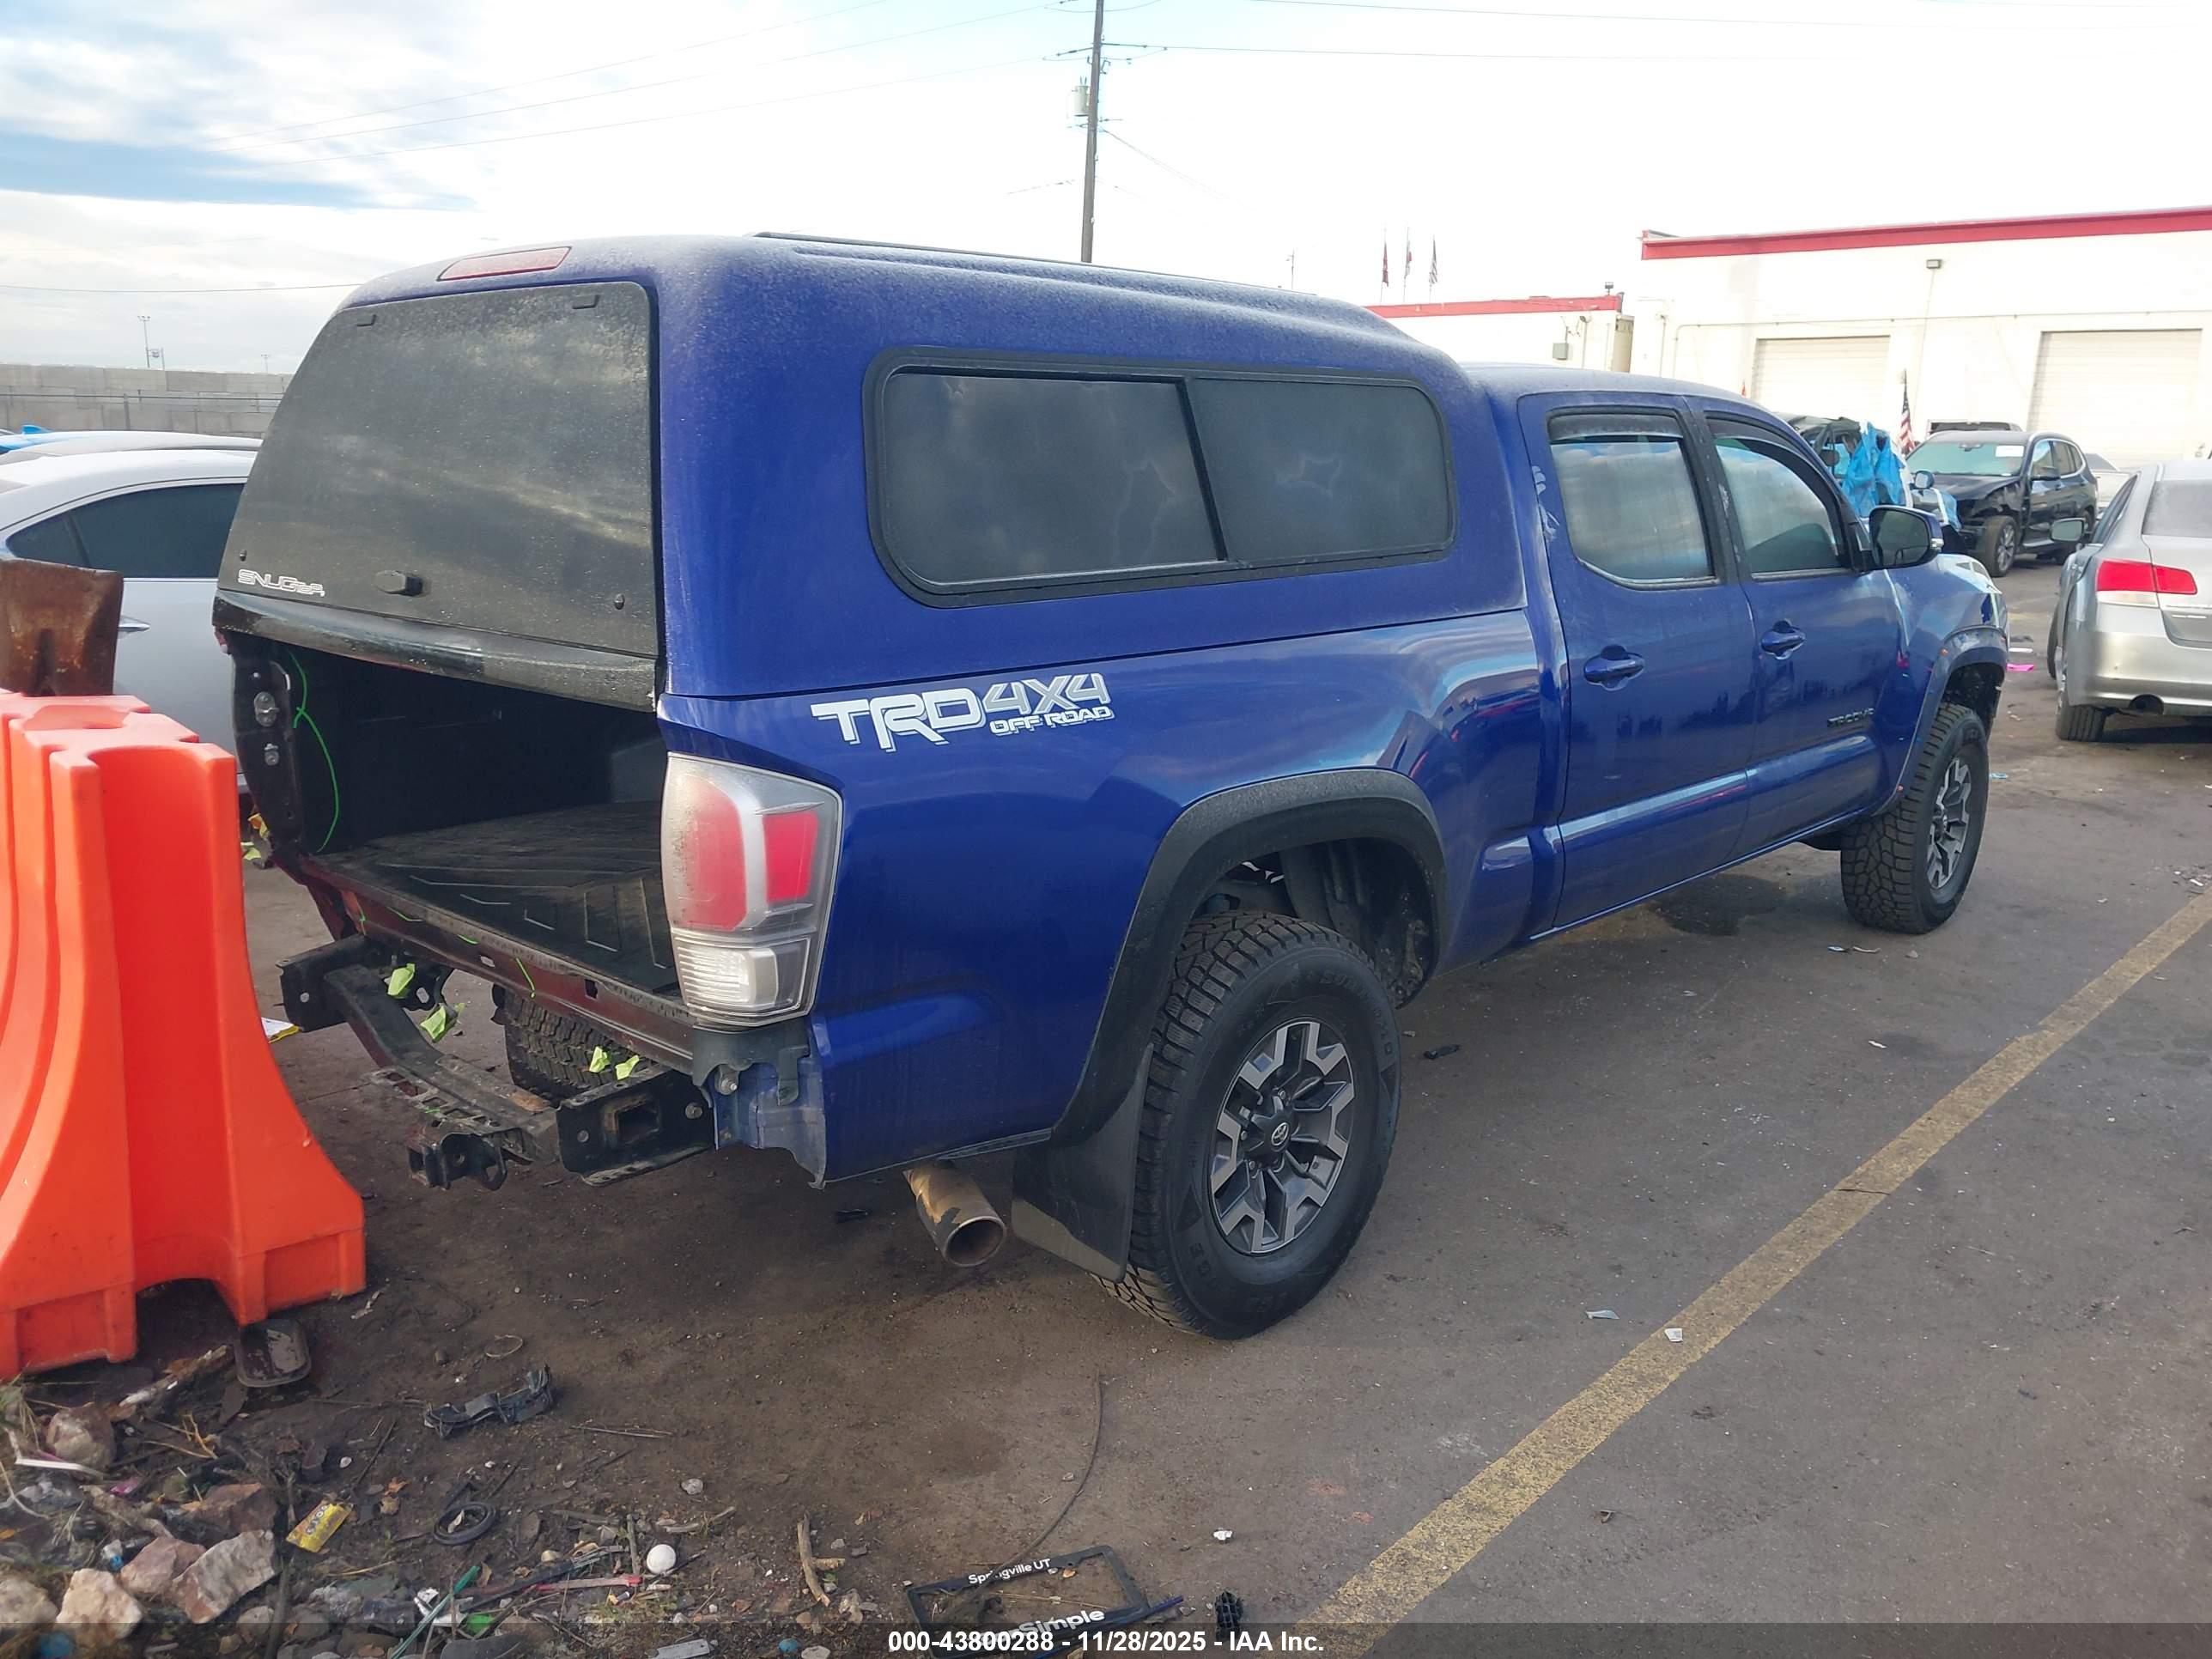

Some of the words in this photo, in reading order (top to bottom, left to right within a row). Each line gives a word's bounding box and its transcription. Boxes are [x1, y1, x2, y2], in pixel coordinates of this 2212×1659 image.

[810, 688, 987, 752] TRD
[983, 672, 1111, 716] 4X4
[989, 715, 1043, 736] OFF
[1044, 706, 1115, 728] ROAD
[968, 1564, 1032, 1583] Sprgville
[1033, 1558, 1051, 1570] UT
